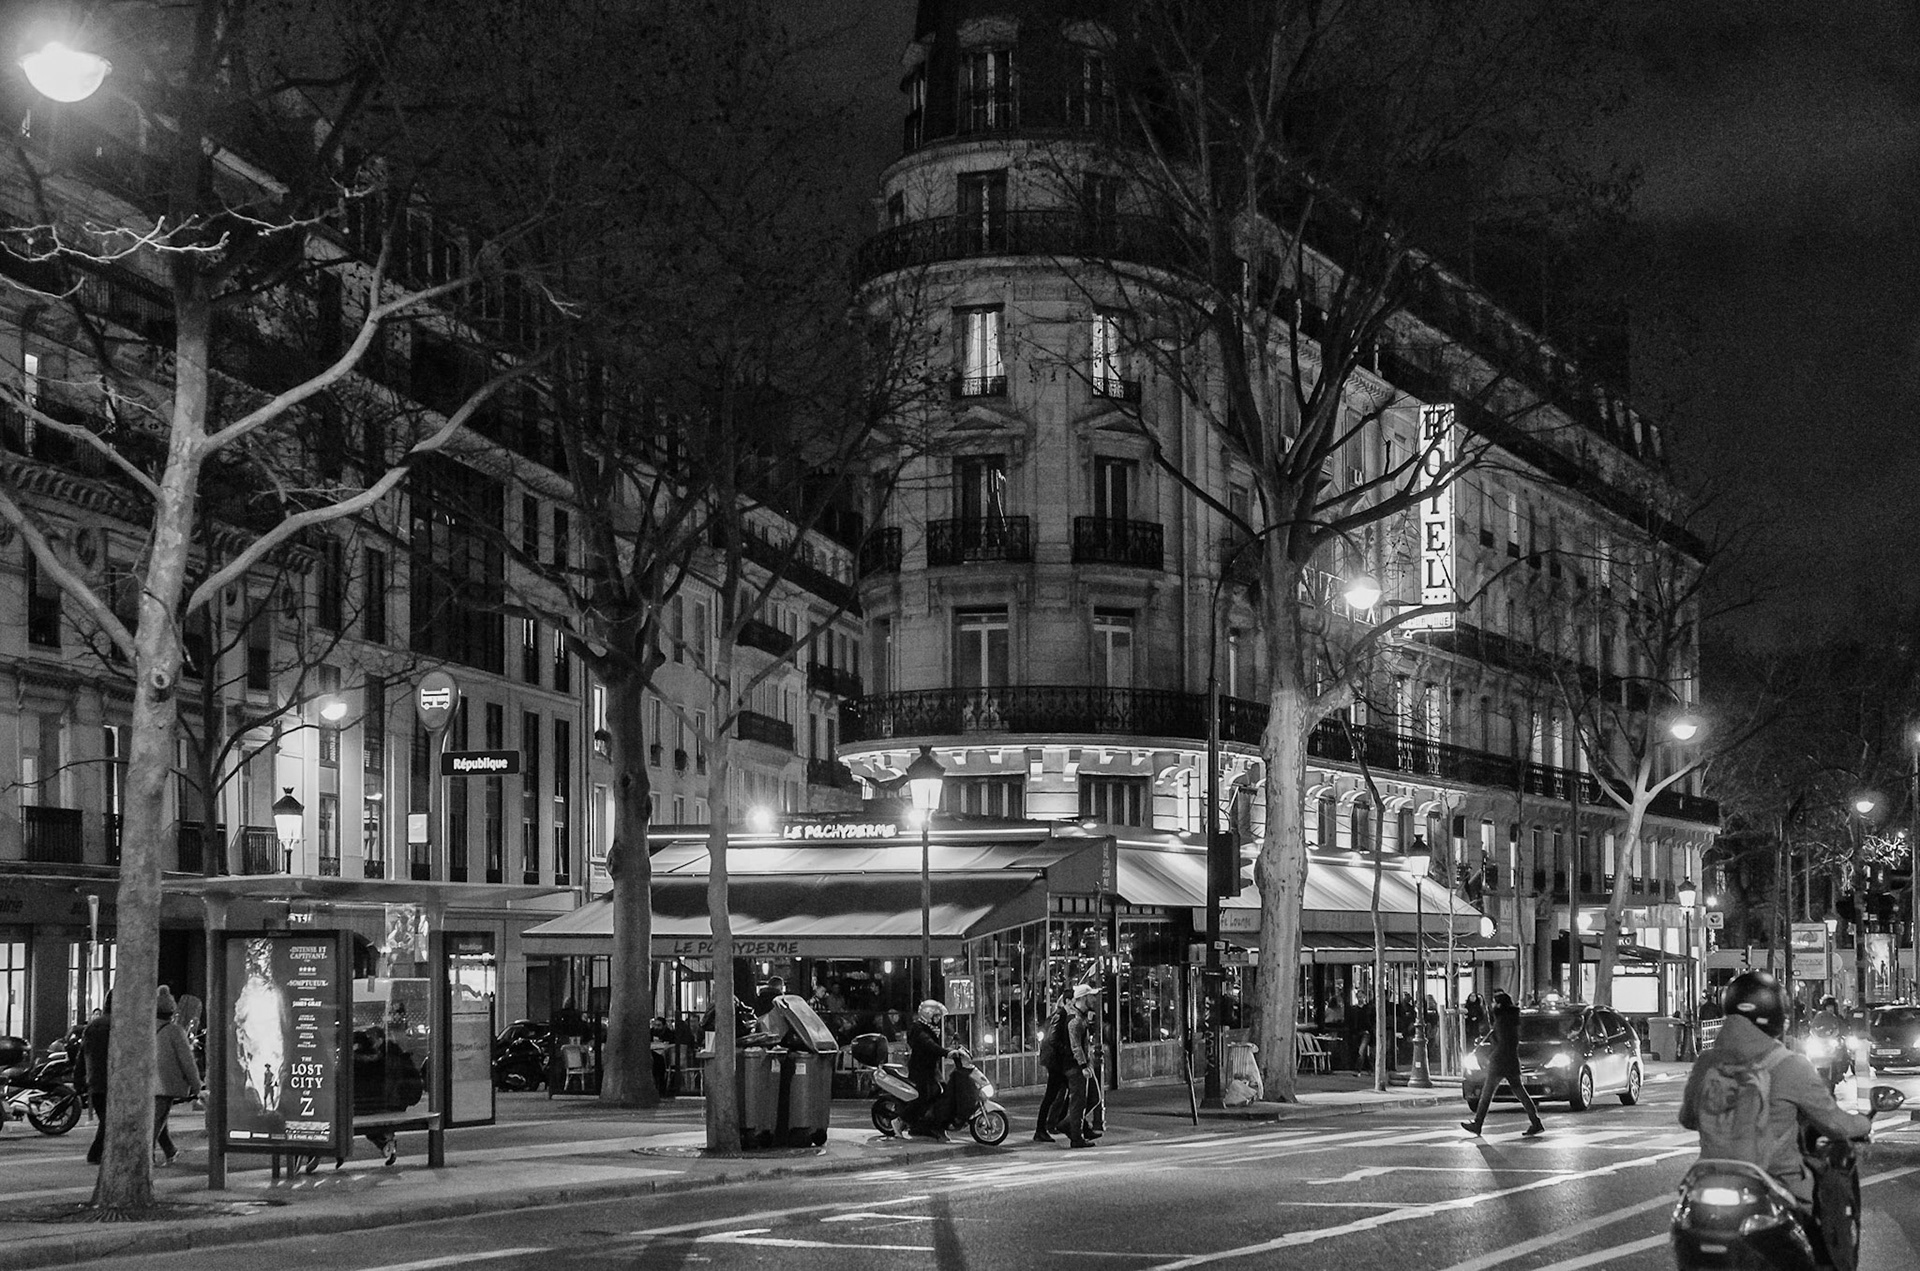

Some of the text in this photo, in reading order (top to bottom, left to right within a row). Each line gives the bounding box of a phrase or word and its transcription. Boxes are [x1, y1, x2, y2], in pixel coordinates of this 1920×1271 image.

[453, 757, 509, 772] République
[783, 825, 802, 839] LE
[674, 941, 693, 954] LE
[291, 1063, 323, 1075] LOST
[290, 1076, 323, 1089] CITY
[300, 1097, 315, 1117] Z
